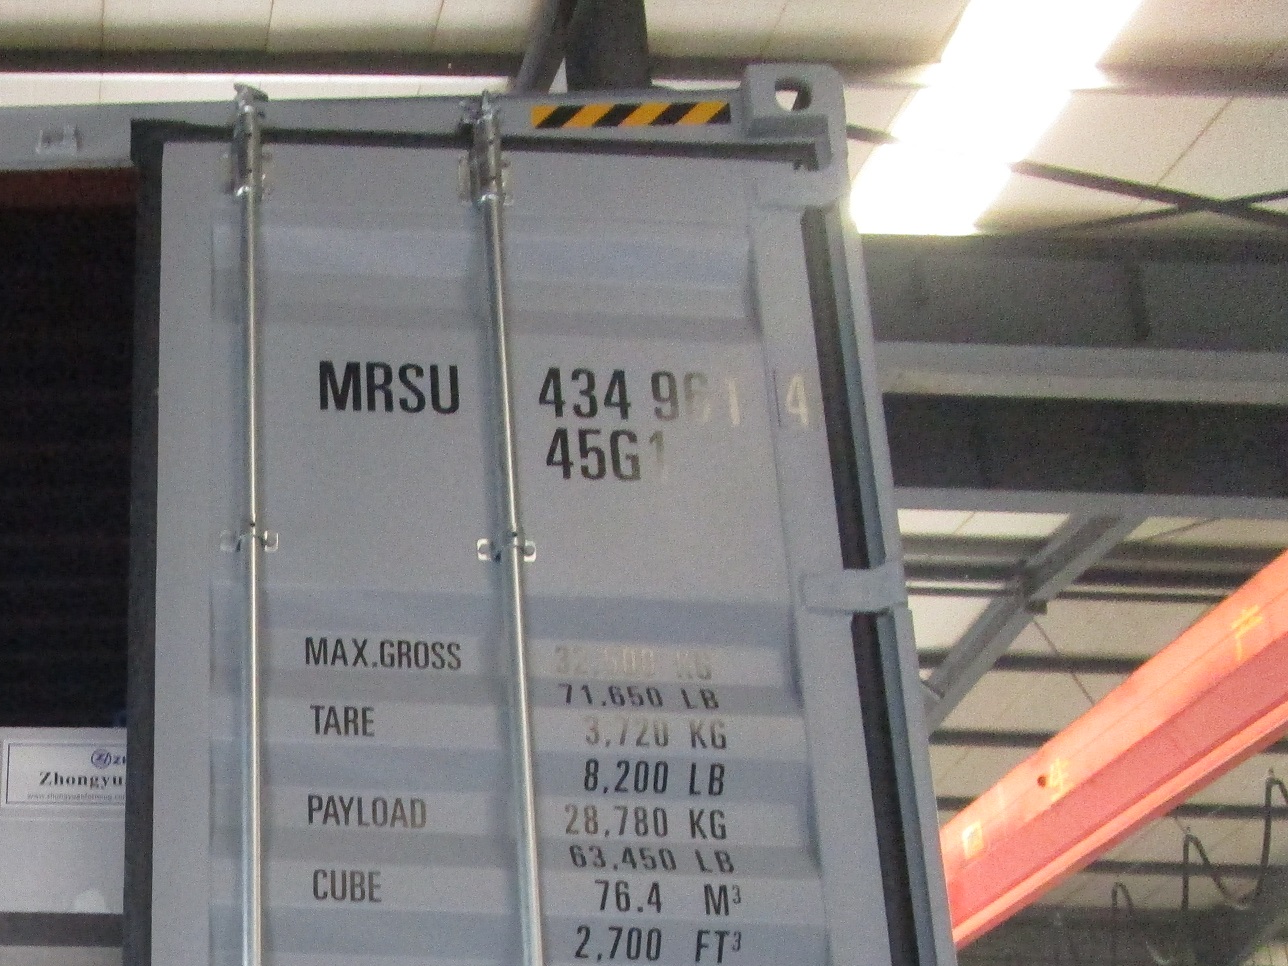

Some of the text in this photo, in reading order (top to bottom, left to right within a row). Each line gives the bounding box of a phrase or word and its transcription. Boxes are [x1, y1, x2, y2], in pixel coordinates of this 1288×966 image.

[318, 361, 460, 415] MRSU
[538, 366, 632, 420] 434
[545, 426, 667, 482] 45G1
[304, 636, 463, 671] MAX.GROSS
[680, 687, 720, 710] LB
[309, 704, 375, 738] TARE
[689, 718, 727, 750] KG
[38, 770, 126, 791] Zhongyu
[583, 757, 726, 797] 8,200 LB
[307, 793, 727, 841] PAYLOAD 28,780 KG
[694, 848, 735, 874] LB
[312, 868, 382, 903] CUBE
[594, 873, 663, 913] 76.4
[574, 923, 663, 962] 2,700
